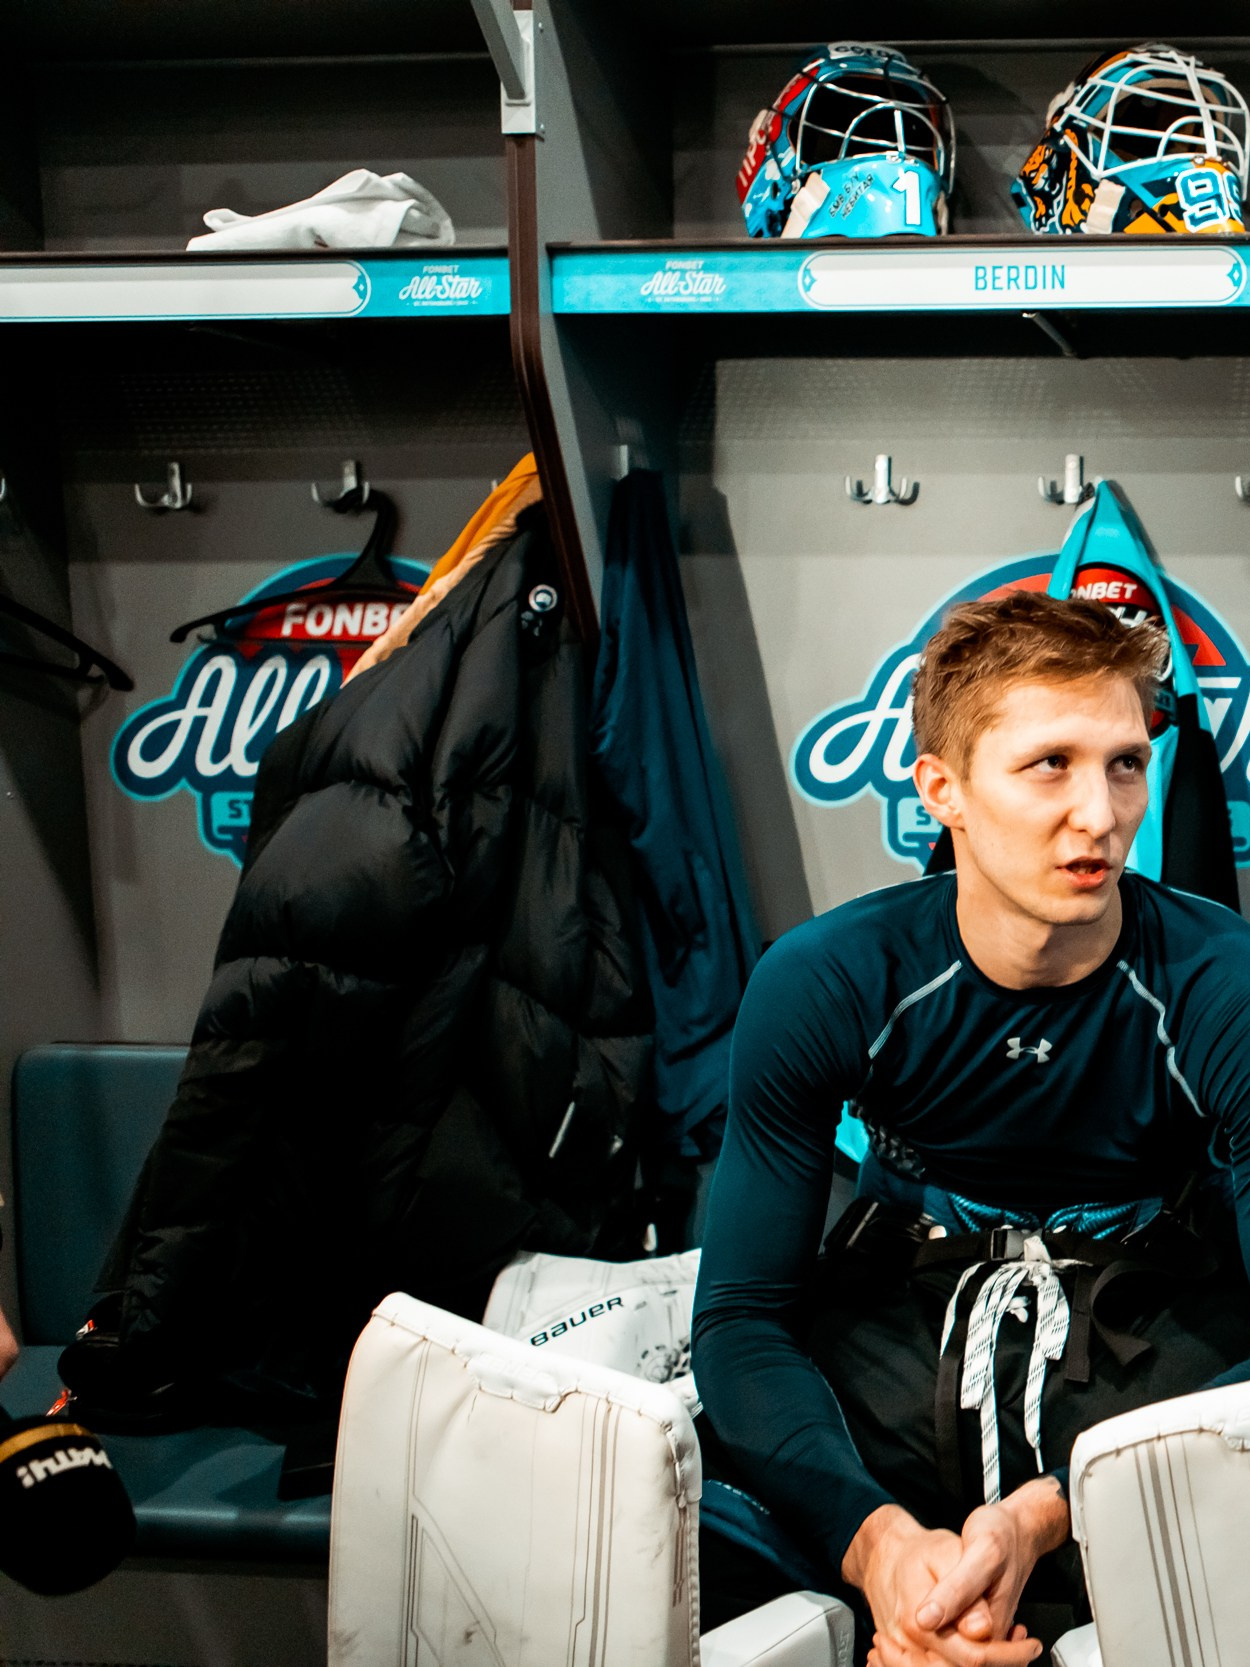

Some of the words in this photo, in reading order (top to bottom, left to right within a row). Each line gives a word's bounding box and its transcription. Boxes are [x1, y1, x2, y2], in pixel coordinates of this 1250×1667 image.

[891, 168, 921, 226] 1
[398, 275, 483, 300] All-Star
[640, 270, 727, 296] All-Star
[975, 264, 1065, 291] BERDIN
